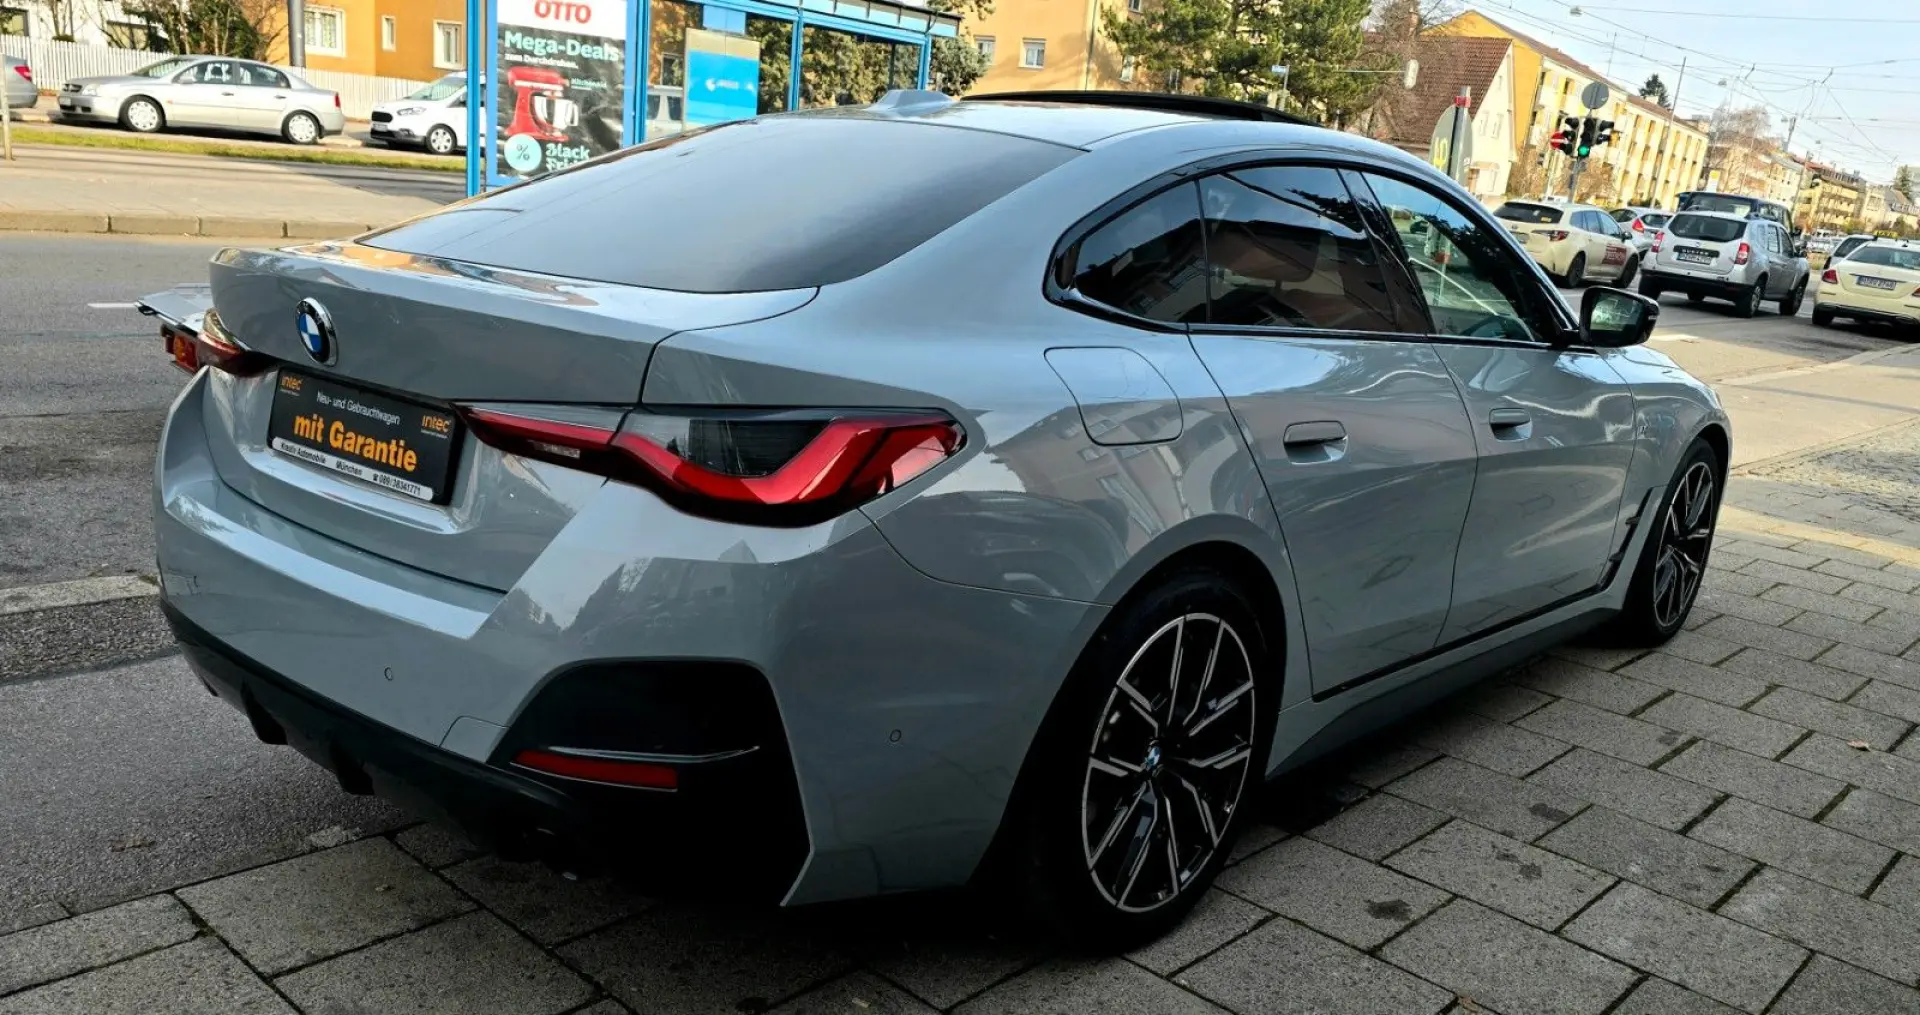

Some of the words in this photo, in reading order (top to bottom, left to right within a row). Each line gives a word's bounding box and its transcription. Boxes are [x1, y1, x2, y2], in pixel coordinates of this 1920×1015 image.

[534, 0, 592, 24] OTTO
[504, 30, 619, 62] Mega-Deals
[546, 143, 590, 161] Black
[317, 390, 332, 405] Neu-
[333, 398, 346, 410] und
[347, 400, 400, 425] Gebrauchtwagen
[421, 415, 450, 432] intec
[294, 414, 325, 443] mit
[329, 420, 418, 472] Garantie
[297, 447, 327, 465] Automobile
[335, 460, 363, 477] München
